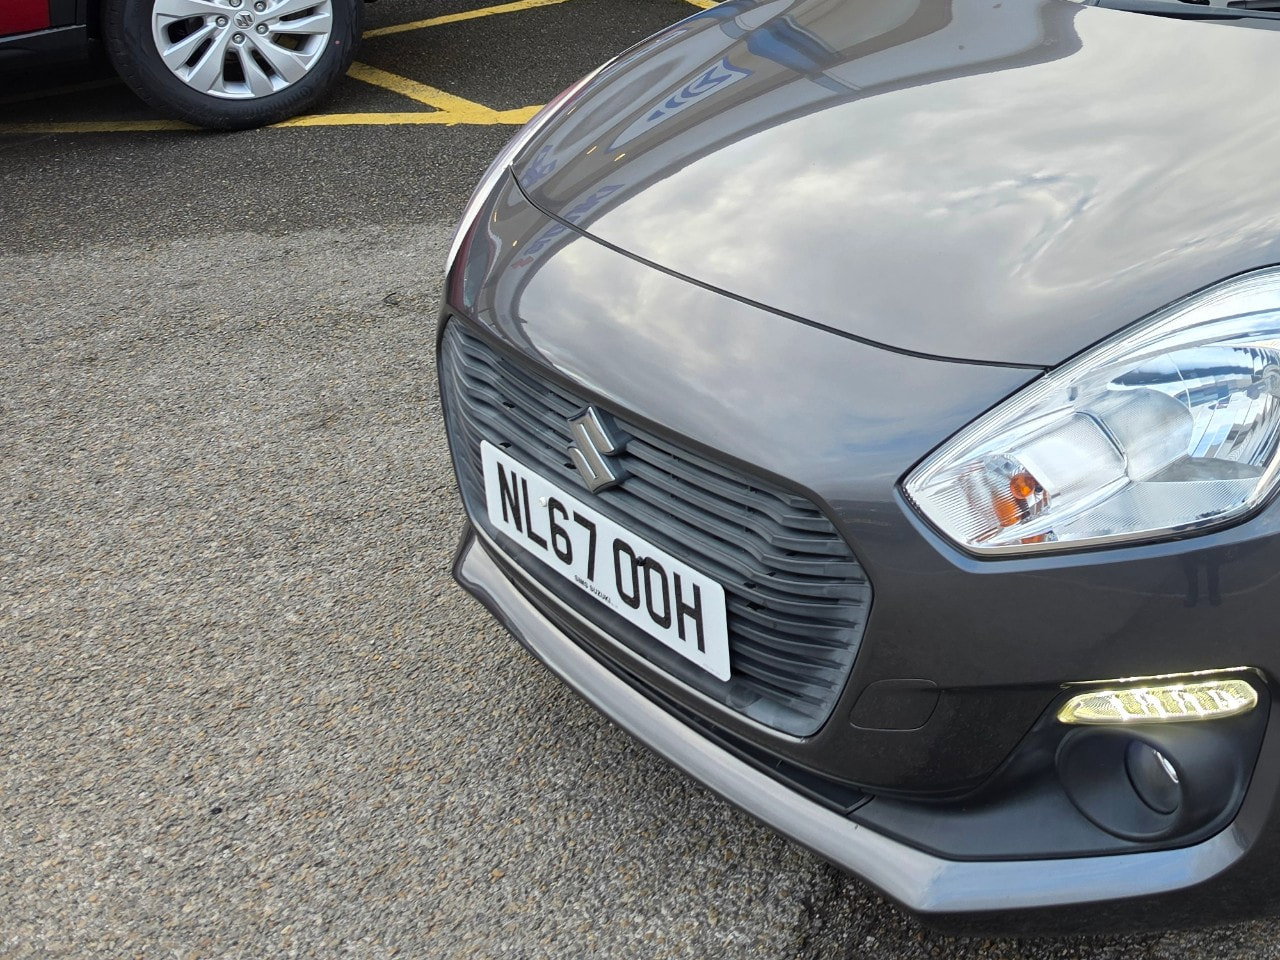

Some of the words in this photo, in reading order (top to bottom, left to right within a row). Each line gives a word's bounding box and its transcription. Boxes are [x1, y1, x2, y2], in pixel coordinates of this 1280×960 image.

[496, 460, 597, 582] NL67
[613, 538, 706, 654] OOH
[574, 574, 589, 589] SIMS
[589, 585, 612, 604] SUZUKI
